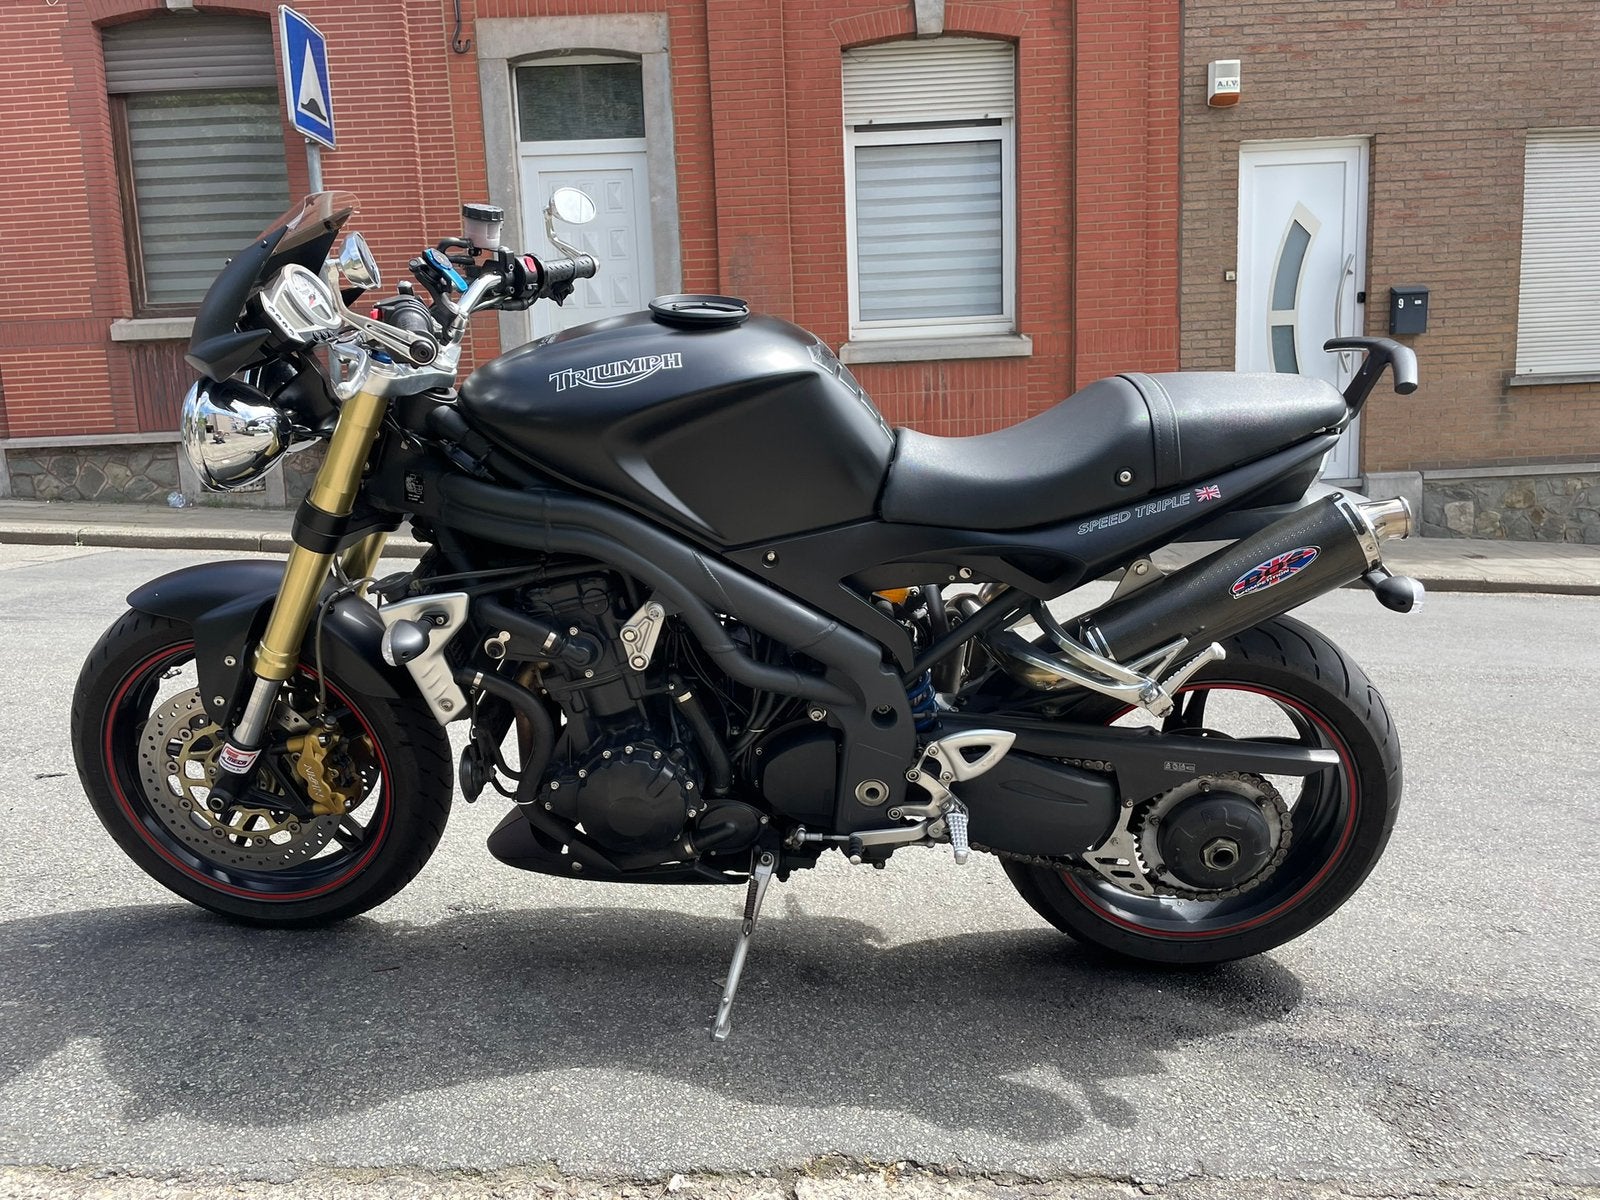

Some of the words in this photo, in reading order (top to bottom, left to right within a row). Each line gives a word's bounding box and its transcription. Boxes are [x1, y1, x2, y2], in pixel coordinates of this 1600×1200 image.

[1398, 298, 1404, 308] 9
[549, 352, 682, 392] TRIUMPH
[1077, 510, 1132, 535] SPEED
[1134, 492, 1191, 518] TRIPLE
